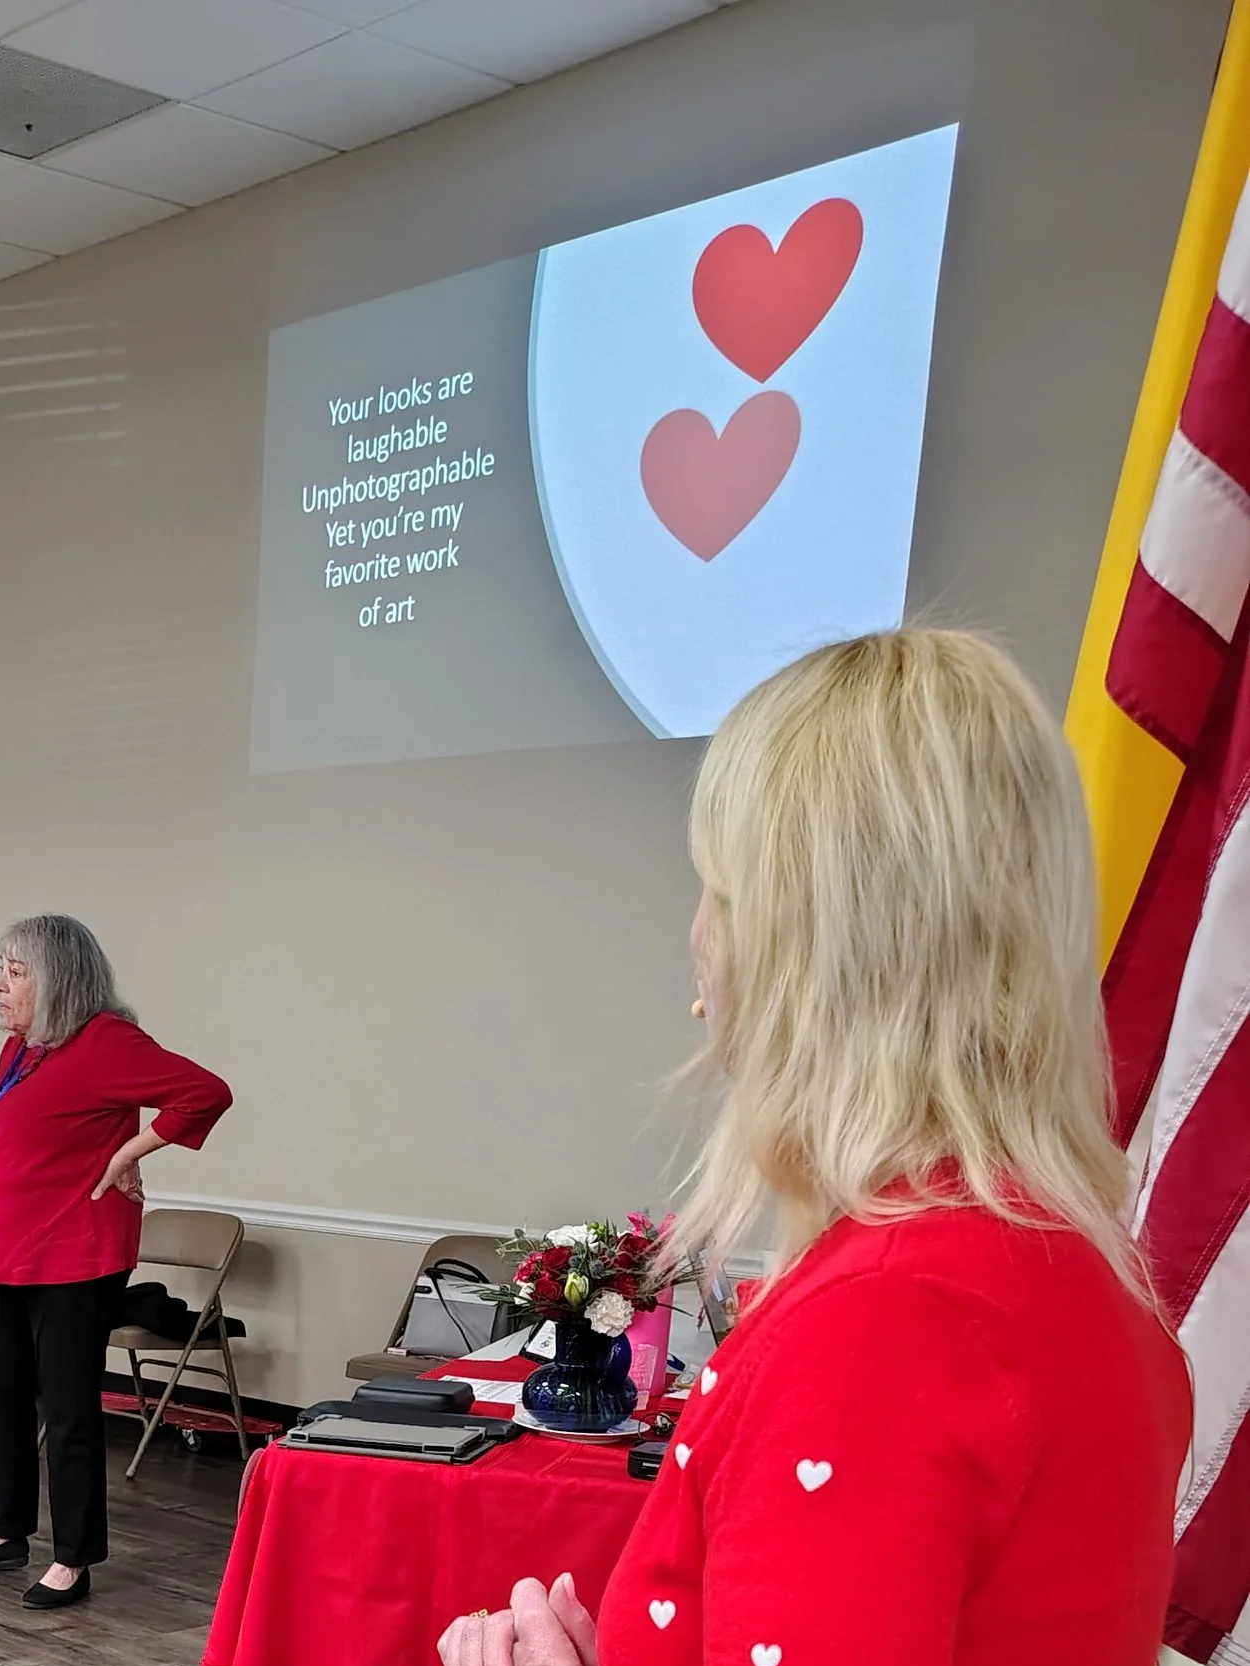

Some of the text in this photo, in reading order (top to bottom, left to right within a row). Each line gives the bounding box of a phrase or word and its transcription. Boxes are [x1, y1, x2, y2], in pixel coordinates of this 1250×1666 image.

[328, 370, 474, 426] Your looks are
[347, 415, 448, 464] laughable
[301, 447, 496, 515] Unphotographable
[325, 502, 464, 550] Yet you're my
[324, 538, 460, 589] favorite work
[358, 595, 416, 628] of art
